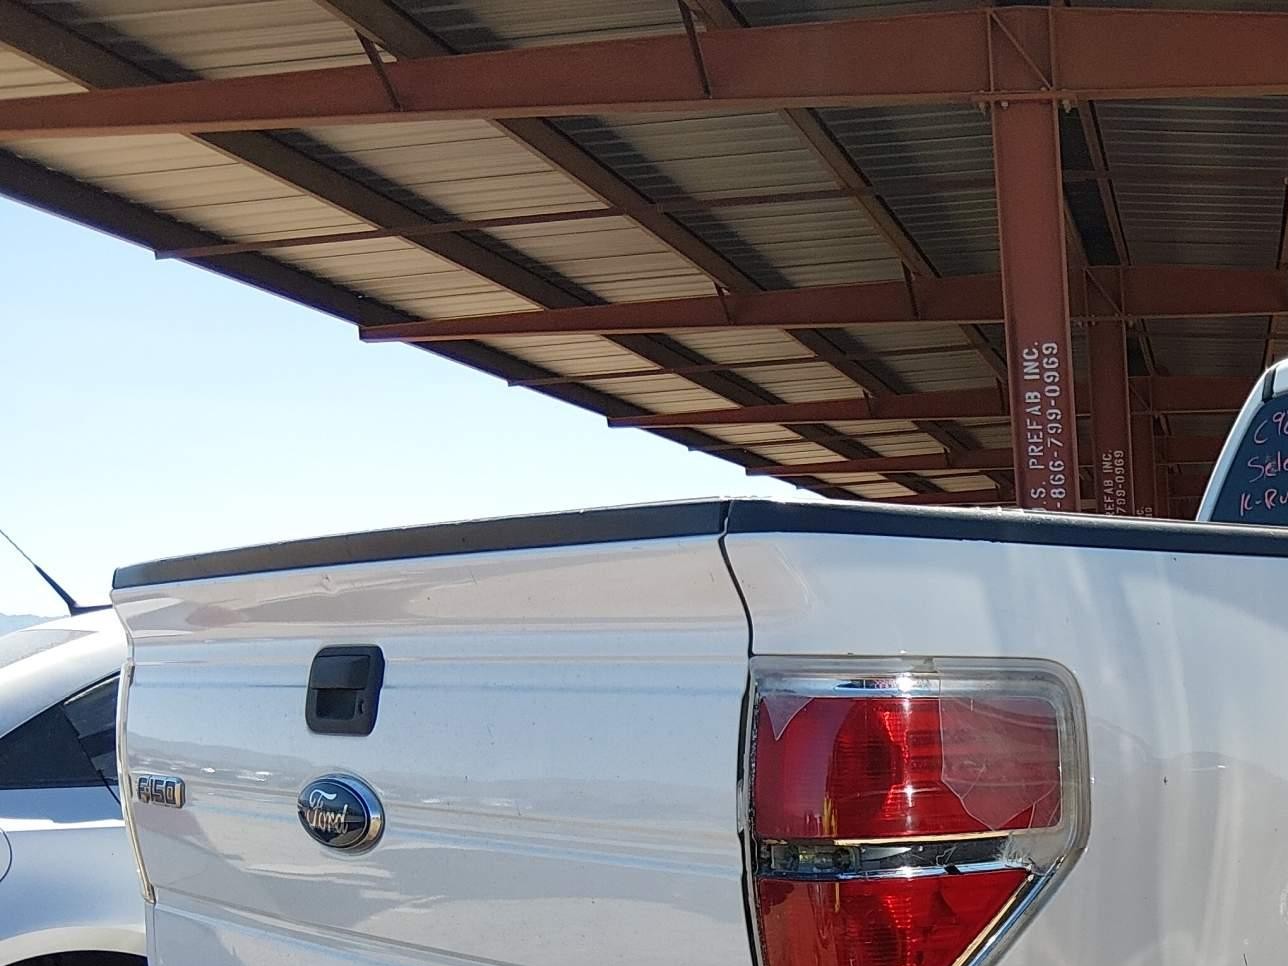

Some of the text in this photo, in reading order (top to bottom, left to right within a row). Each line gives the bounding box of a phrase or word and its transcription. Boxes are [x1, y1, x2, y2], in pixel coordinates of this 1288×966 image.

[1022, 341, 1047, 512] .S. PREFAB INC.
[305, 788, 350, 835] Ford
